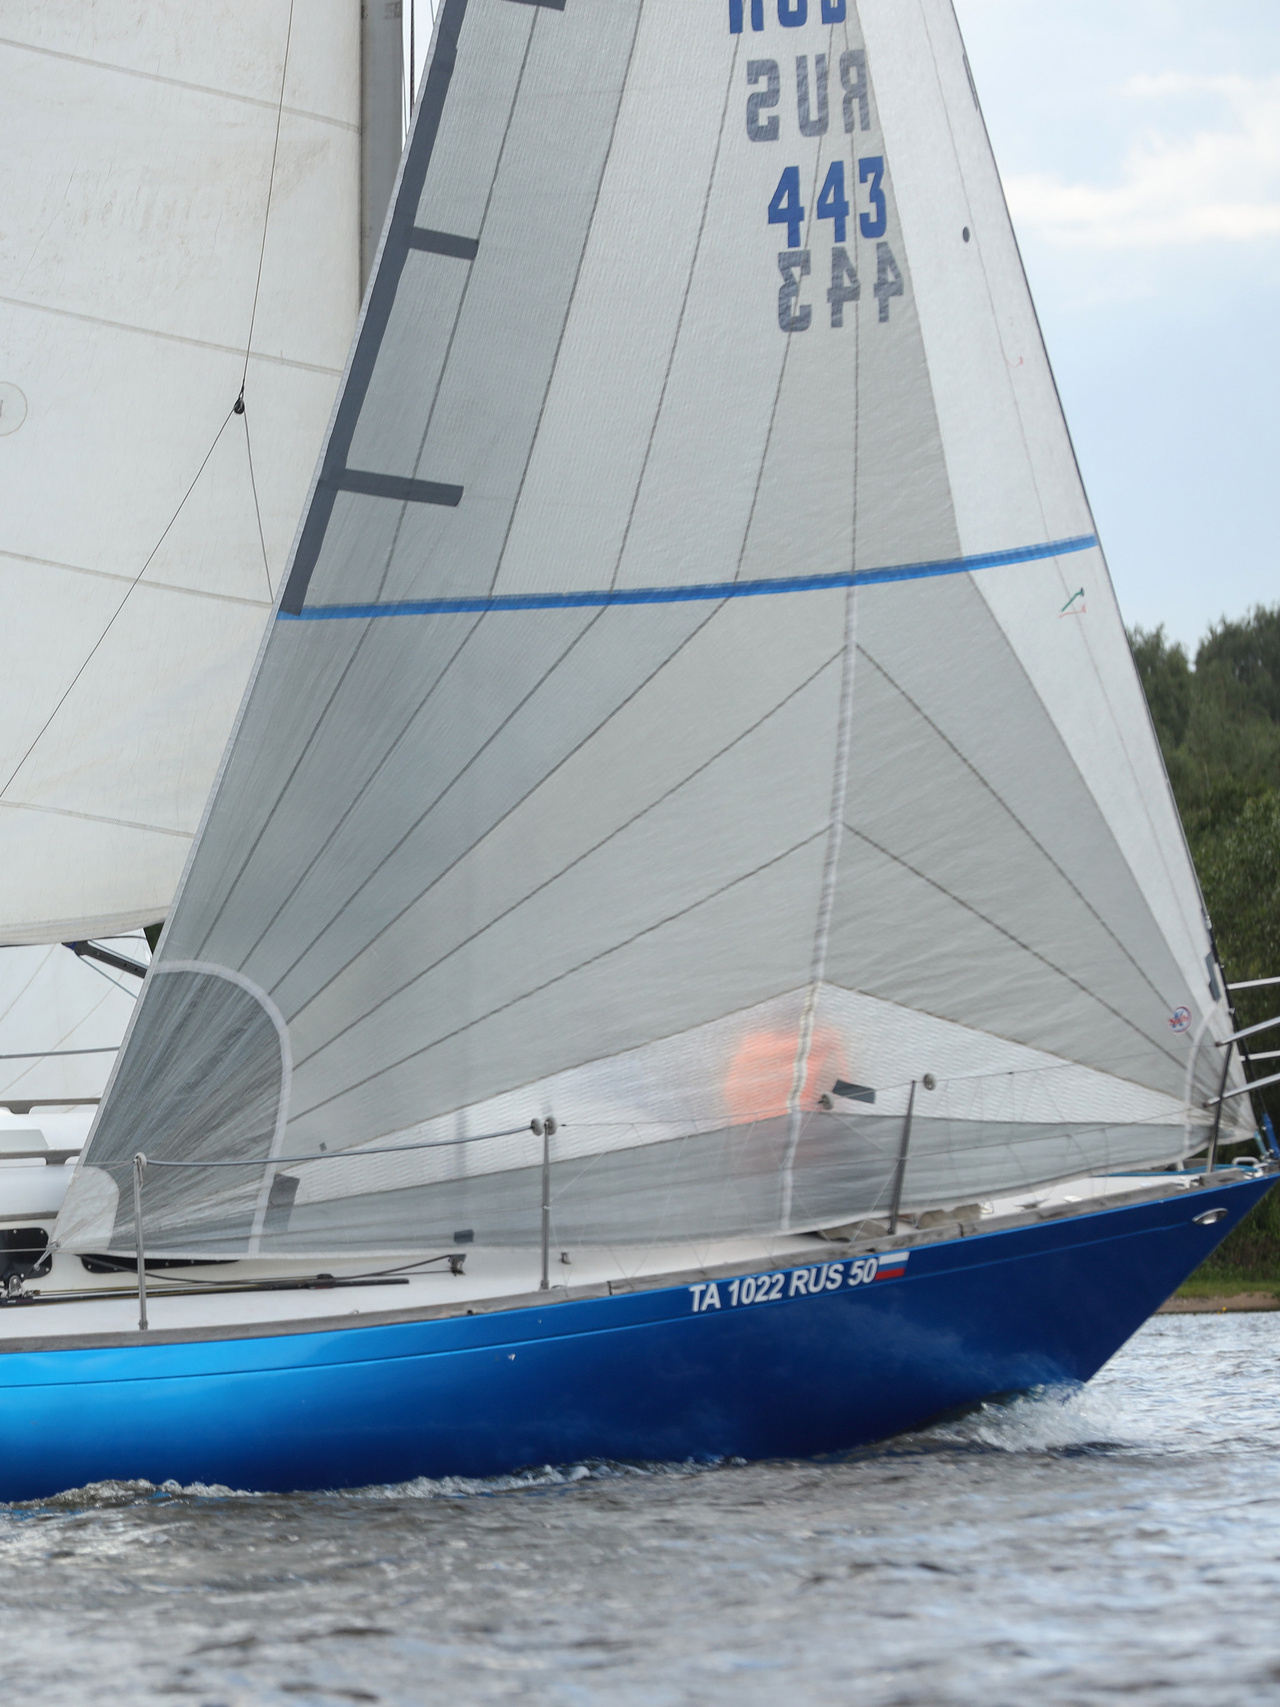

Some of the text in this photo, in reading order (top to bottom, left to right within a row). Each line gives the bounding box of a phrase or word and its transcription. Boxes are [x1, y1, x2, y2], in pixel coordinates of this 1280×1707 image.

[768, 156, 887, 248] 443
[689, 1258, 879, 1312] TA 1022 RUS 50
